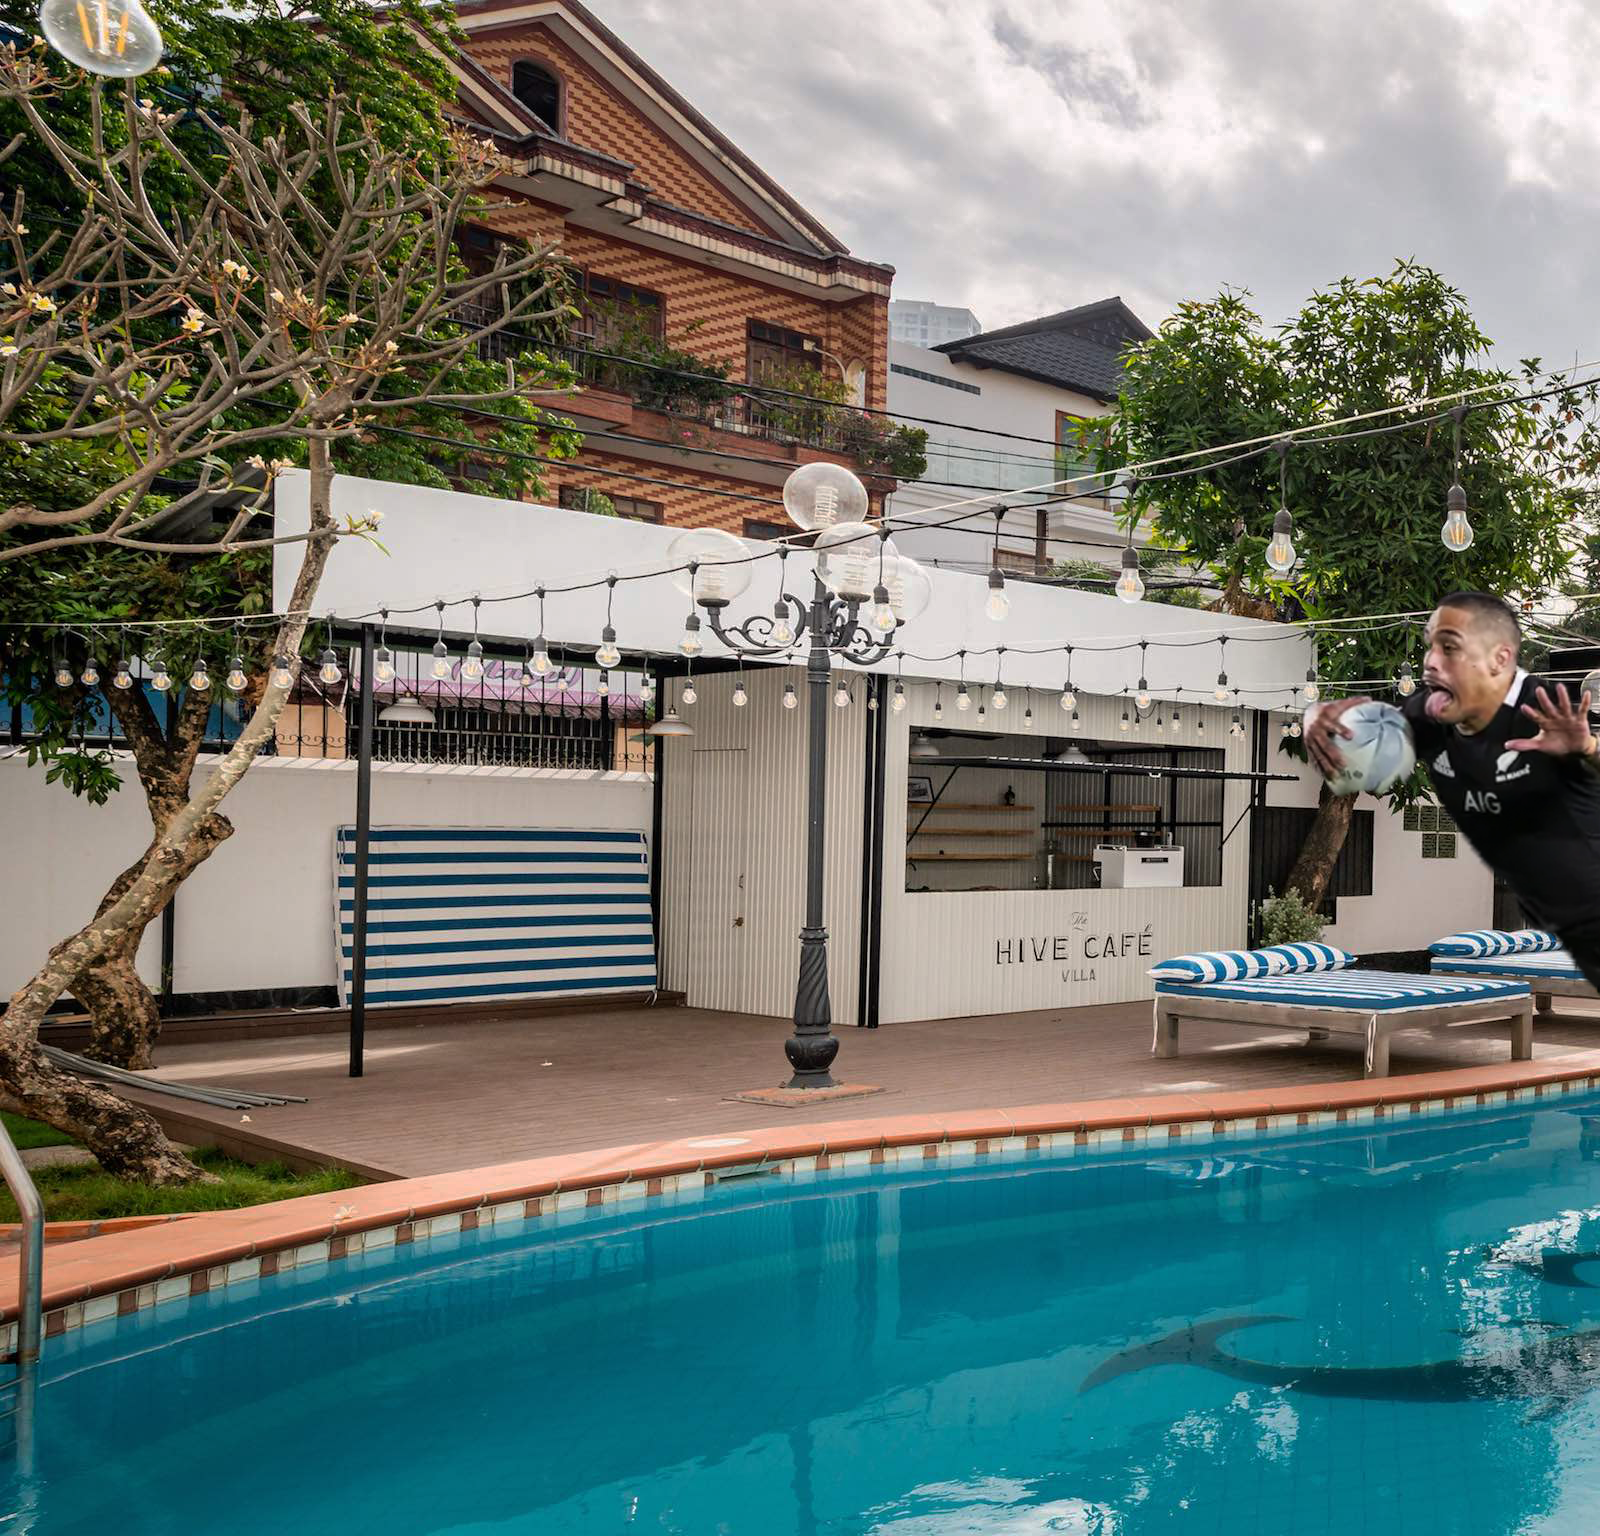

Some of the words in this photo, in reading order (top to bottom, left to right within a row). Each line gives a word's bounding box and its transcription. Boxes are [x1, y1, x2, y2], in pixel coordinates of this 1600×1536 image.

[1464, 790, 1502, 814] AIG
[996, 937, 1069, 965] HIVE
[1084, 923, 1153, 959] CAFÉ
[1062, 969, 1096, 982] VILLA
